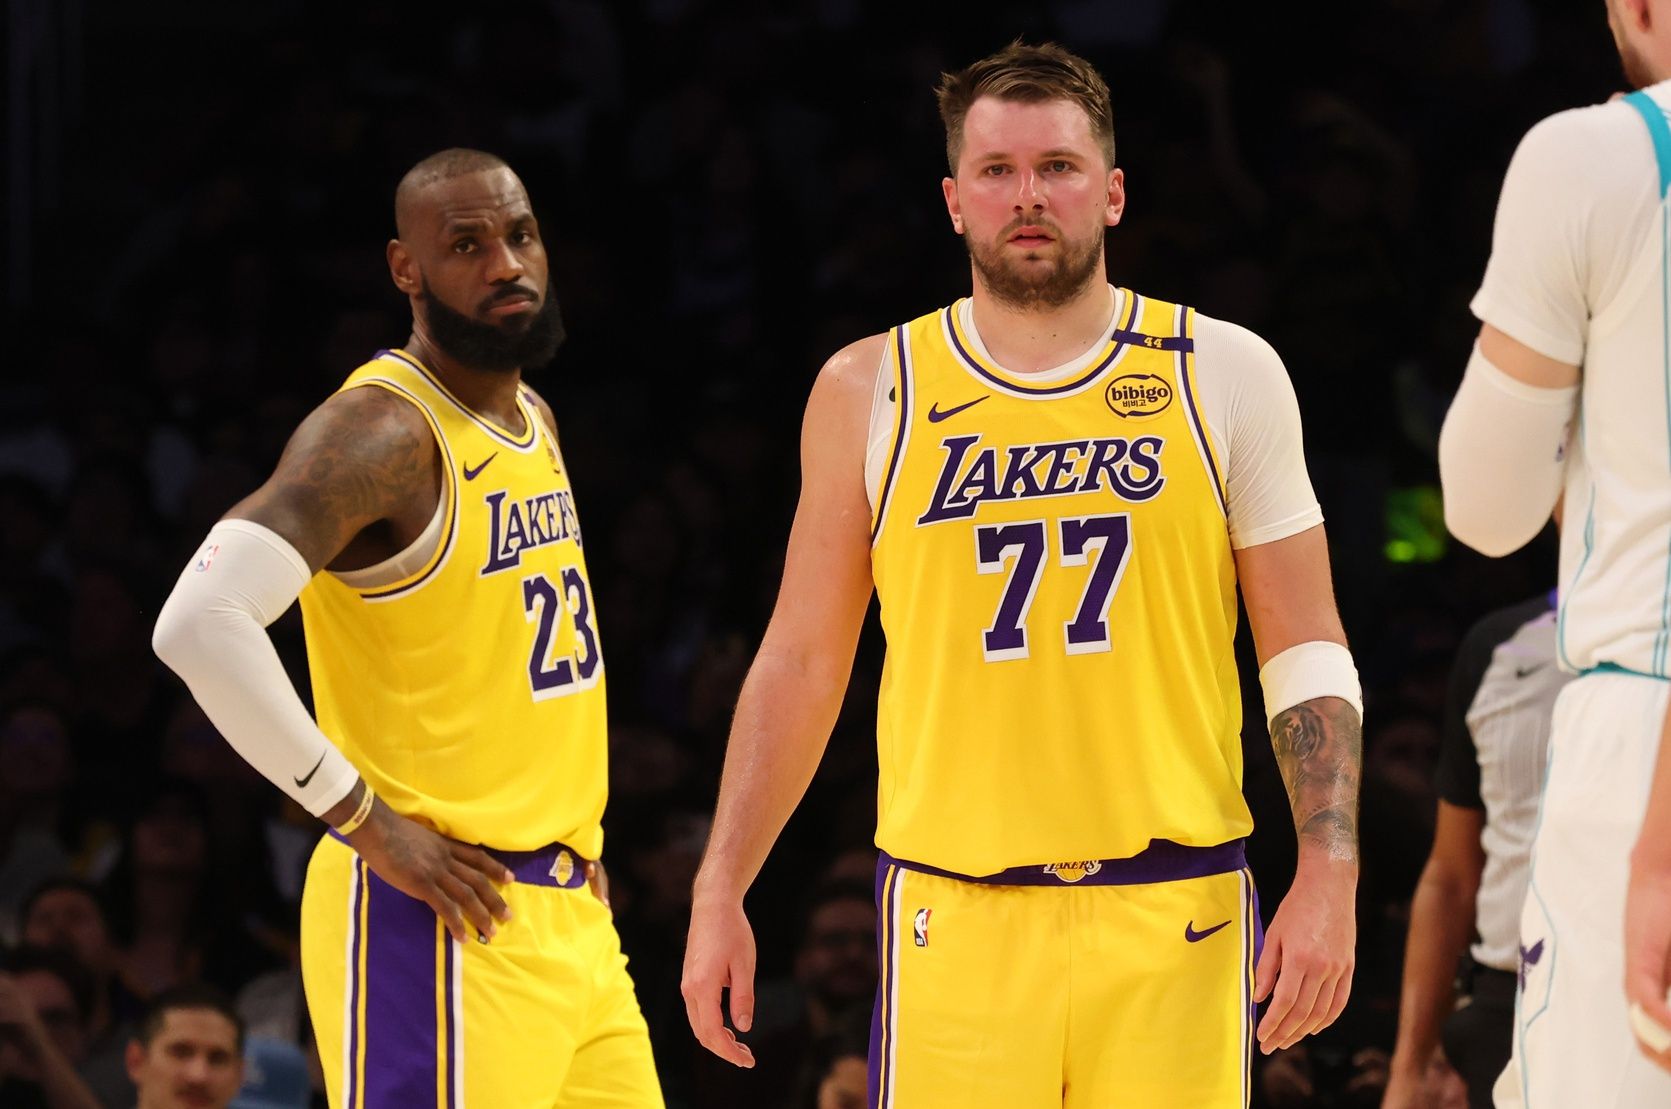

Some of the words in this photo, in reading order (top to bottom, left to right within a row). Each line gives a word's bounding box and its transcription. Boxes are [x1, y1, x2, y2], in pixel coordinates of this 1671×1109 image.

[1144, 337, 1163, 348] 44
[1111, 385, 1169, 402] bibigo
[1122, 399, 1147, 408] 비비고
[916, 433, 1166, 526] LAKERS
[975, 513, 1132, 661] 77
[524, 566, 603, 702] 23
[1043, 860, 1101, 875] LAKERS
